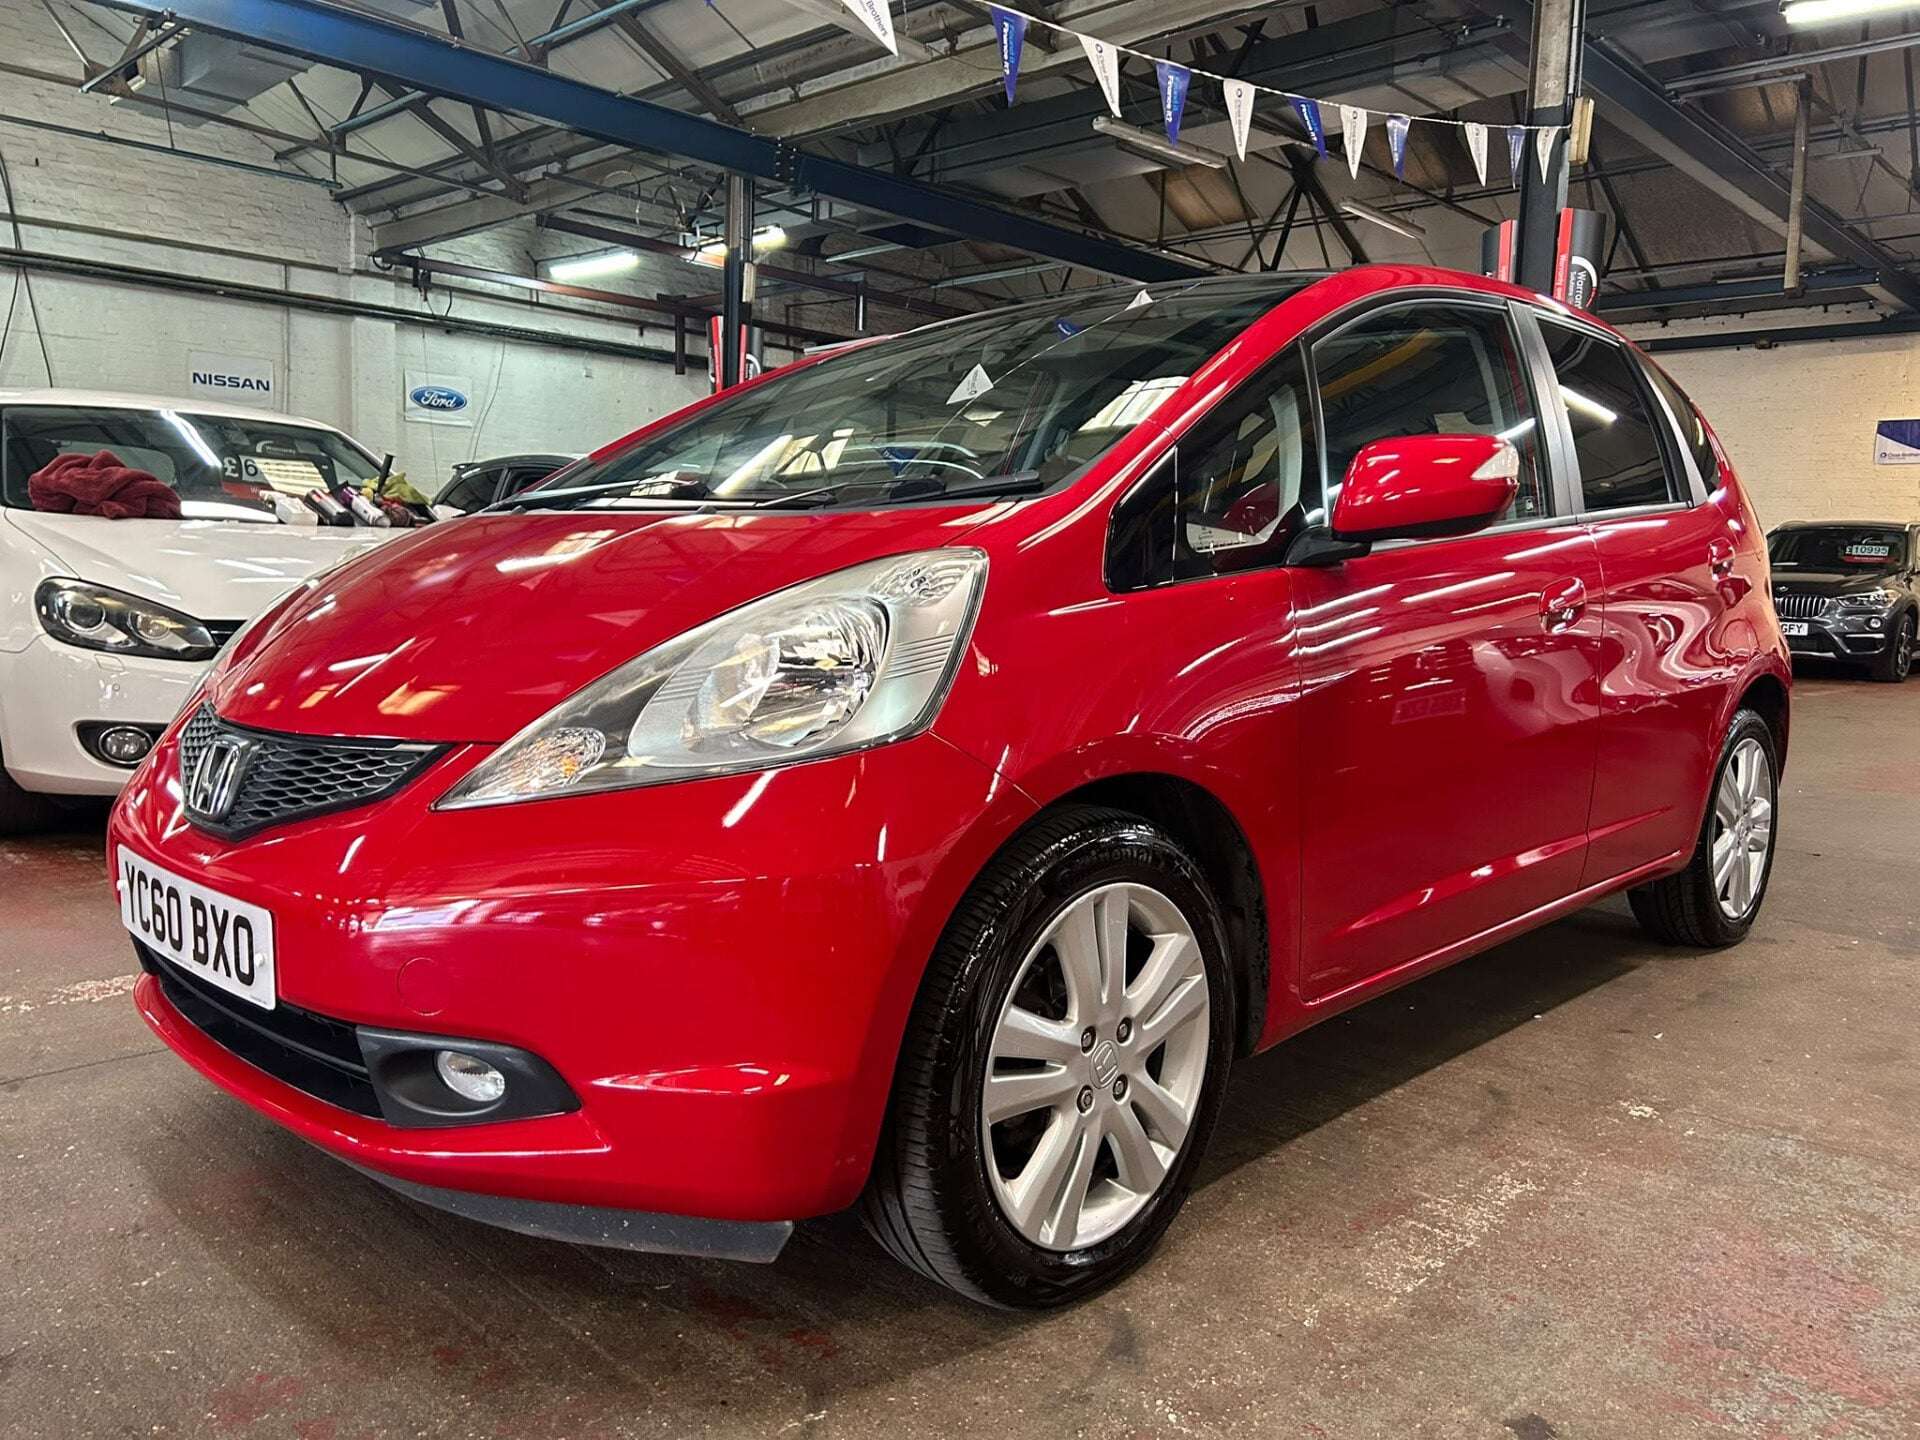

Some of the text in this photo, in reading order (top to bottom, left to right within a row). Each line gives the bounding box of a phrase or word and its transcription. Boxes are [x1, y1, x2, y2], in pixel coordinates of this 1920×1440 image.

[1002, 21, 1010, 60] Finance
[1166, 75, 1174, 109] Finance
[192, 372, 270, 391] NISSAN
[421, 390, 457, 408] Ford
[124, 860, 256, 987] YC60 BXO
